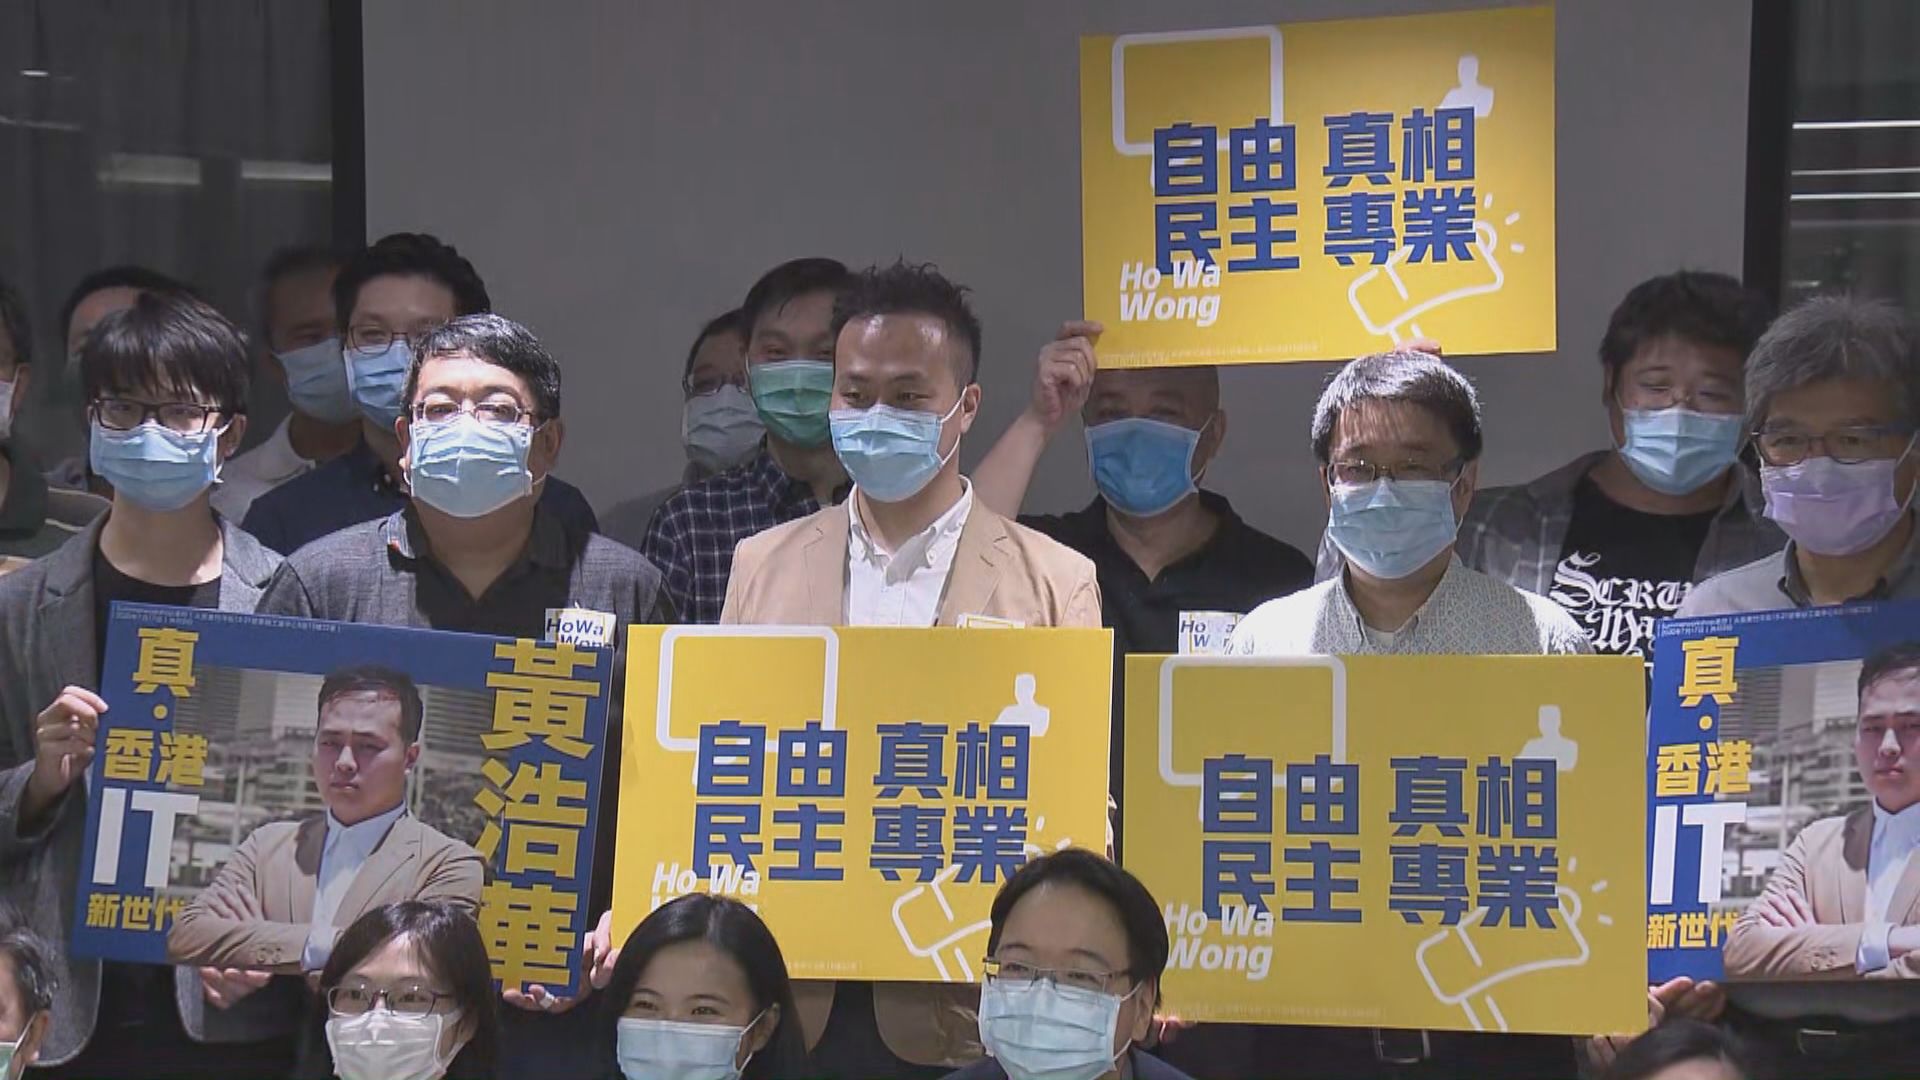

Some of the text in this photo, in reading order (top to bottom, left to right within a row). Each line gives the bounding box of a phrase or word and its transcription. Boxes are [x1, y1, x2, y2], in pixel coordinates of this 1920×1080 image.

[1153, 106, 1475, 196] 自由 真相
[1155, 187, 1477, 275] 民主 專業
[1119, 259, 1221, 292] Ho Wa
[1119, 291, 1221, 328] Wong
[104, 729, 208, 787] 香港
[696, 719, 1031, 800] 自由 真相
[1656, 740, 1752, 798] 香港
[1202, 754, 1558, 838] 自由 真相
[92, 787, 201, 888] IT
[692, 803, 1027, 884] 民主 專業
[1650, 802, 1747, 906] IT
[651, 863, 761, 896] Ho Wa
[1202, 841, 1559, 929] 民主 專業
[86, 893, 186, 932] 新世代
[1164, 903, 1275, 937] Ho Wa
[1647, 912, 1739, 950] 新世代
[1166, 942, 1273, 981] Wong
